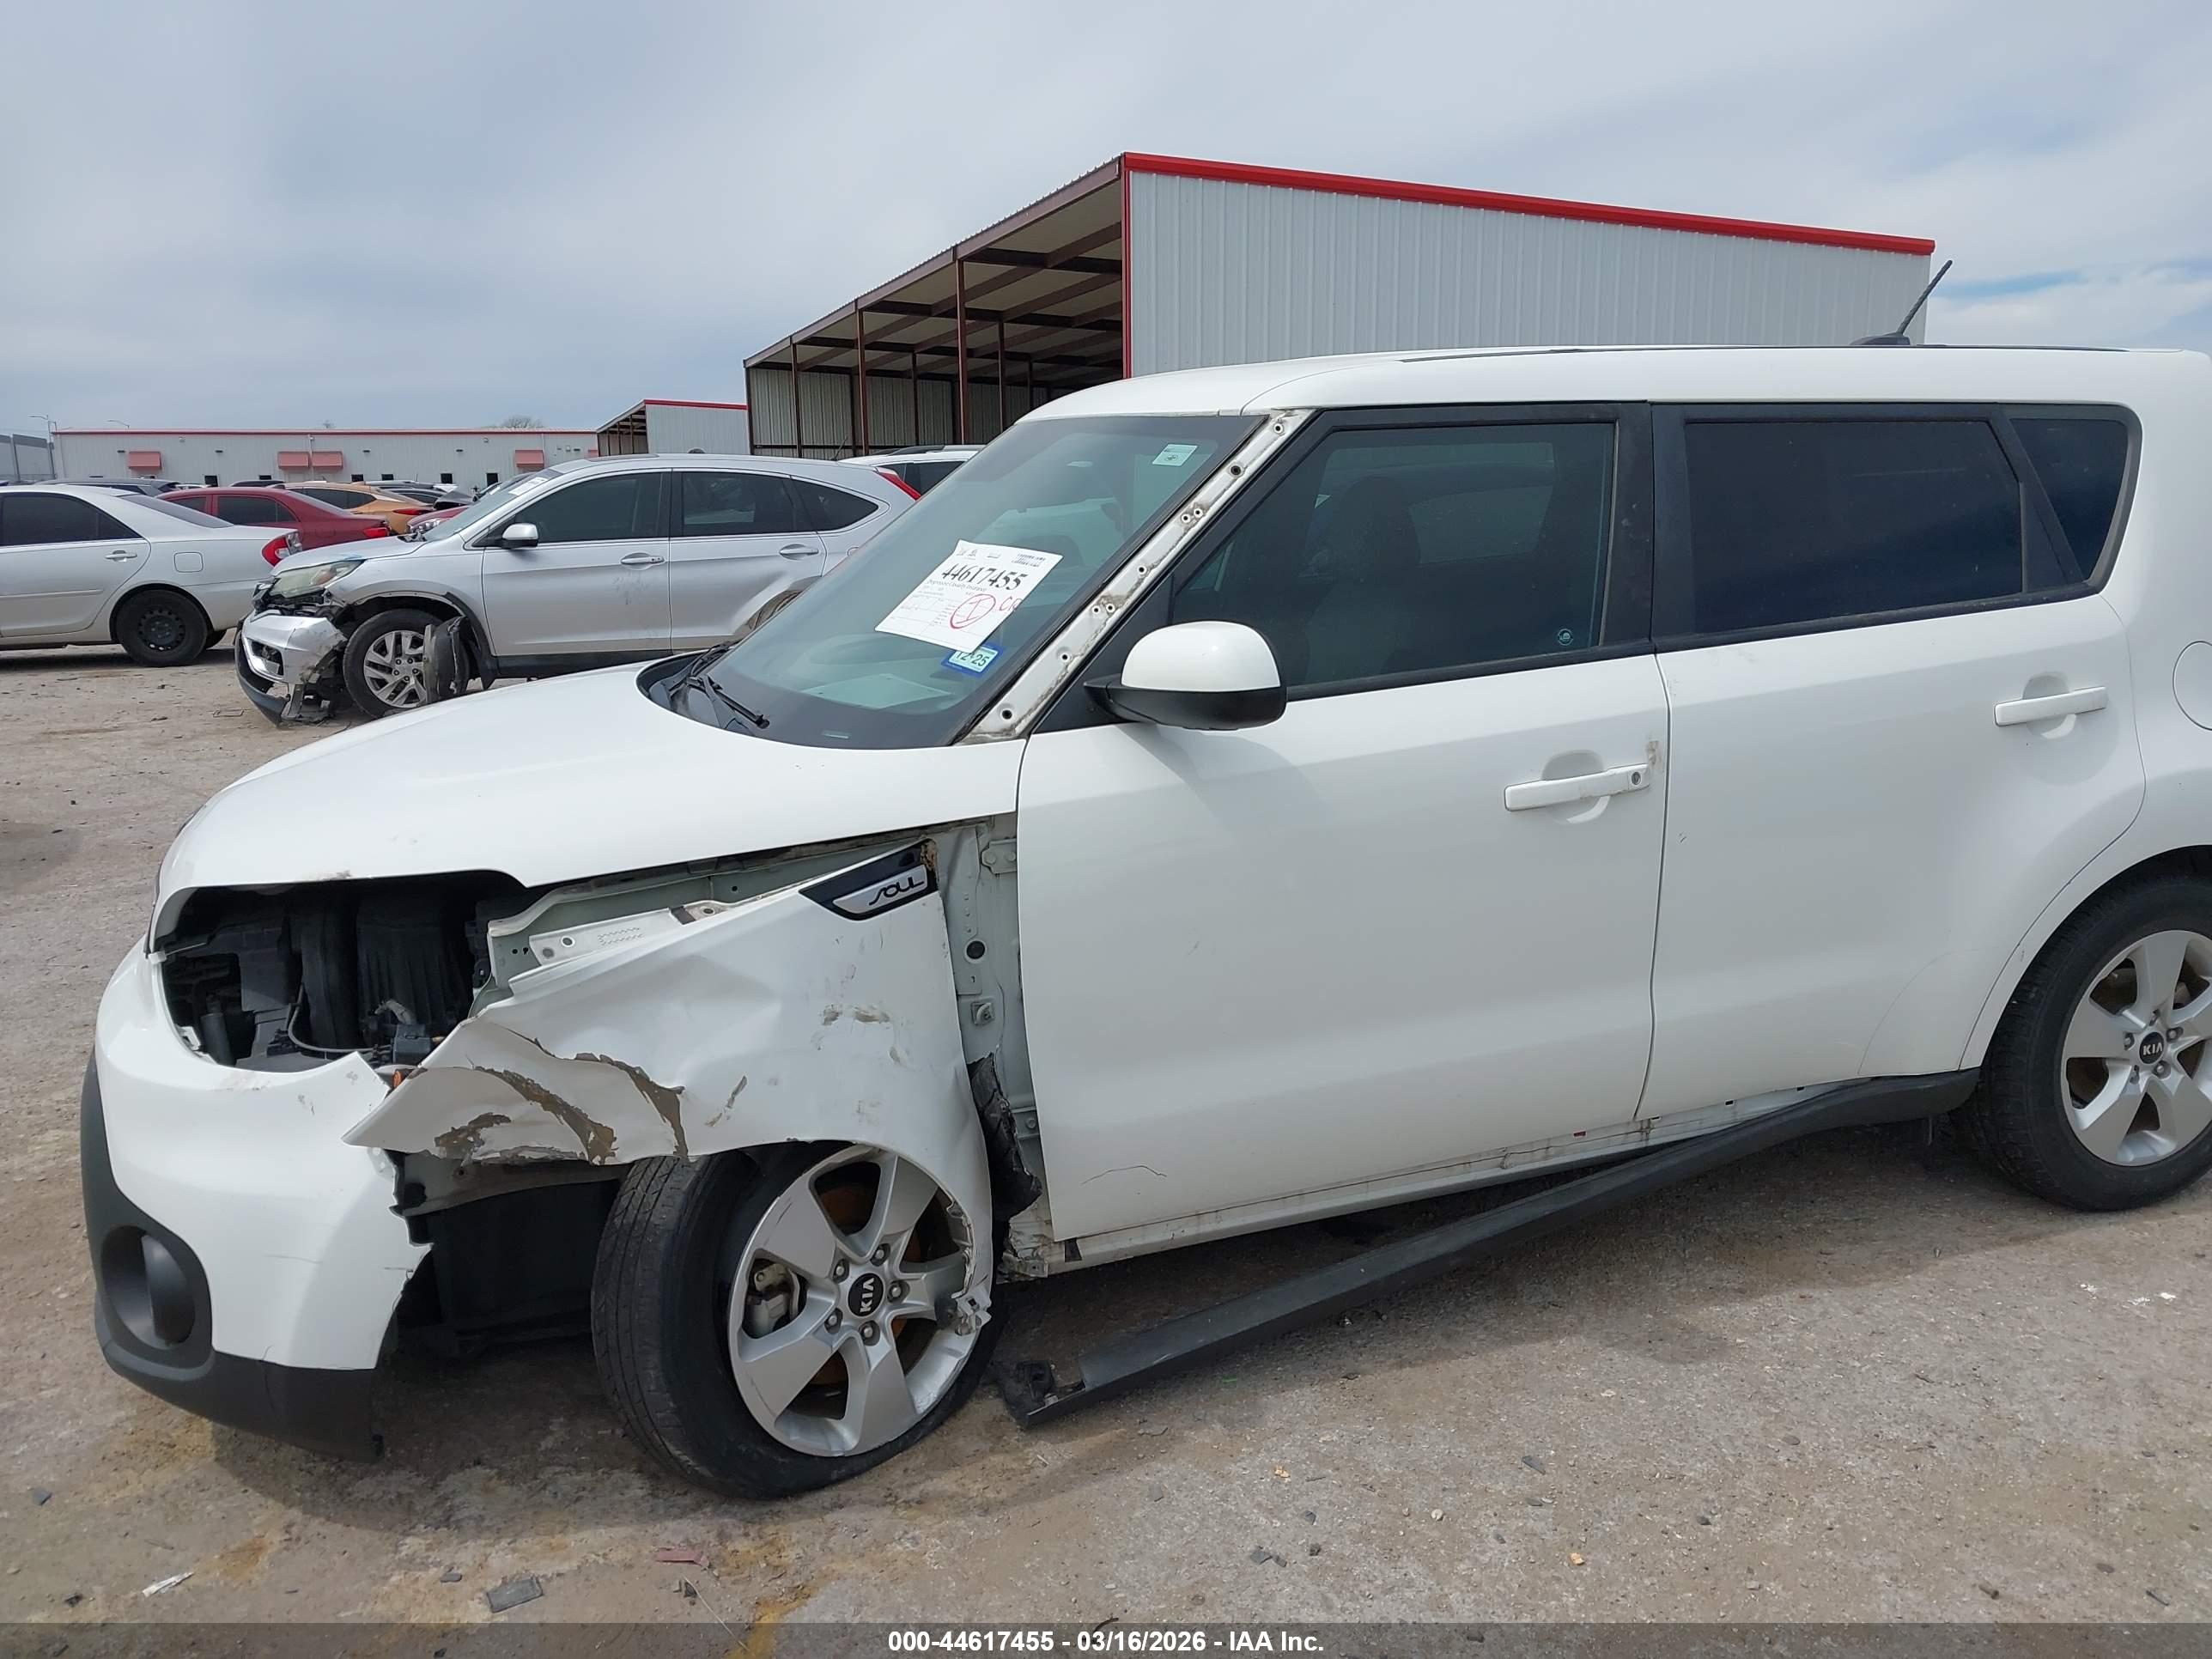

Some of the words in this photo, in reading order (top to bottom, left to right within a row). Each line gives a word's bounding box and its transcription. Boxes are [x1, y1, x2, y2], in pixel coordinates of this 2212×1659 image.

[941, 562, 1029, 591] 44617455
[970, 653, 990, 667] 25
[868, 877, 925, 907] SOUL
[2142, 1042, 2163, 1056] KIA
[860, 1277, 875, 1313] KIA
